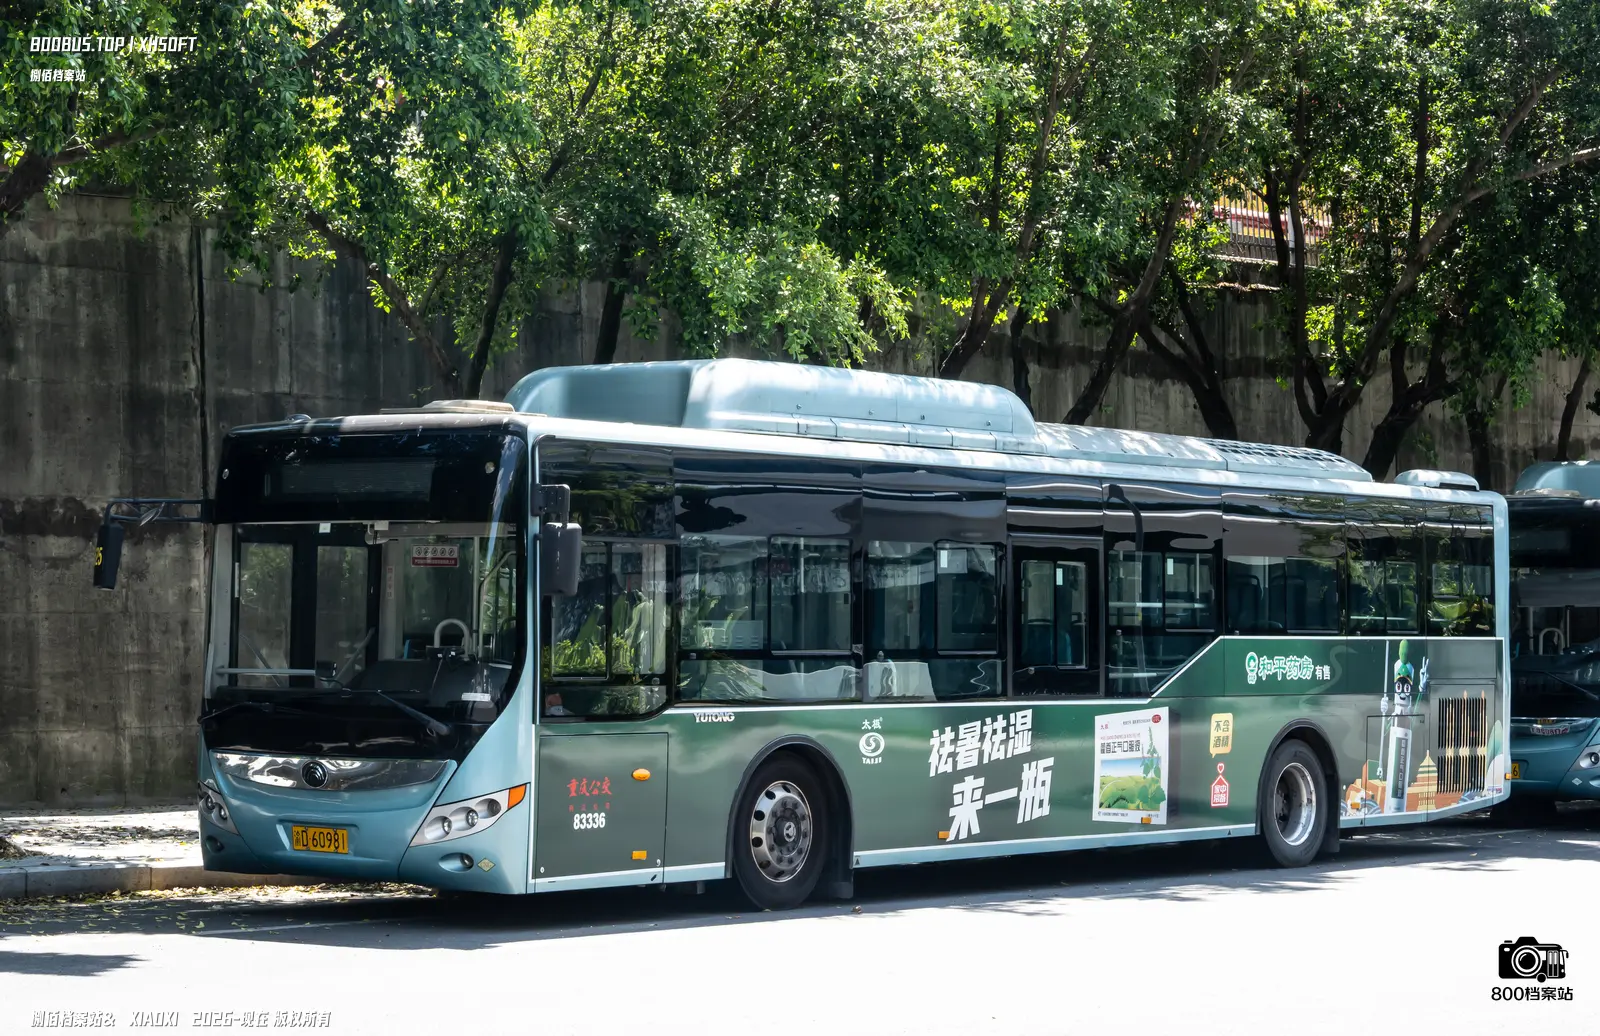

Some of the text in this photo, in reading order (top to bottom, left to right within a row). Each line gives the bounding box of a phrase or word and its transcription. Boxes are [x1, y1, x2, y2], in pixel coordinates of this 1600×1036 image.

[1258, 655, 1314, 681] 和平药房
[1315, 665, 1331, 680] 有售
[693, 711, 735, 723] YUTONG
[1214, 720, 1230, 733] 不含
[928, 709, 1033, 778] 祛暑祛湿
[566, 776, 613, 797] 重庆公交
[946, 757, 1055, 842] 来一瓶
[573, 812, 606, 830] 83336
